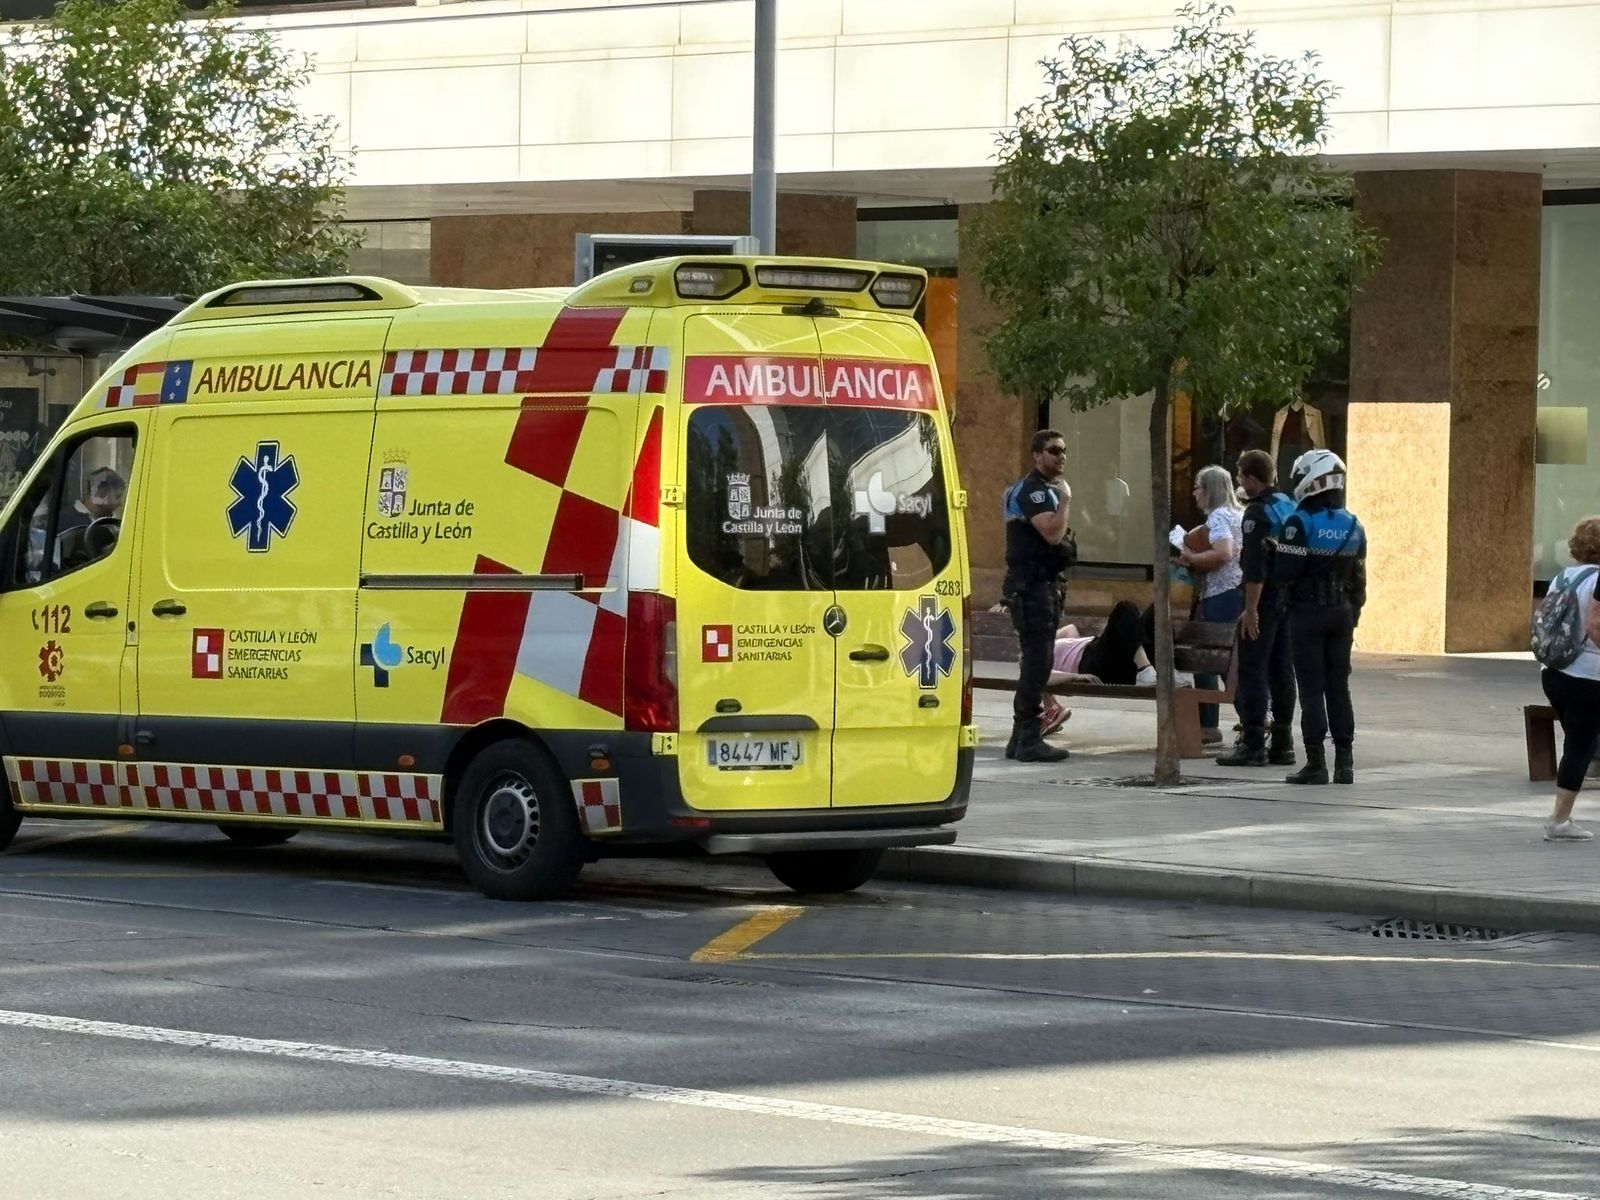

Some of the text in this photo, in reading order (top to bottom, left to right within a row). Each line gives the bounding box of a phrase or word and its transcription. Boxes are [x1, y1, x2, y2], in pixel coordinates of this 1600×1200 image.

[194, 360, 372, 395] AMBULANCIA
[705, 364, 924, 402] AMBULANCIA
[408, 499, 474, 516] Junta de
[753, 506, 802, 519] Junta de
[897, 493, 932, 518] Sacyl
[367, 521, 472, 544] Castilla y León
[722, 520, 802, 537] Castilla y León
[1317, 528, 1349, 540] POLIC
[41, 604, 71, 634] 112
[229, 628, 318, 644] CASTILLA Y LEÓN
[737, 624, 781, 635] CASTILLA
[782, 624, 789, 634] Y
[737, 638, 803, 648] EMERGENCIAS
[228, 647, 302, 663] EMERGENCIAS
[406, 645, 445, 671] Sacyl
[737, 651, 793, 662] SANITARIAS
[228, 665, 289, 680] SANITARIAS
[720, 741, 800, 762] 8447 MFJ
